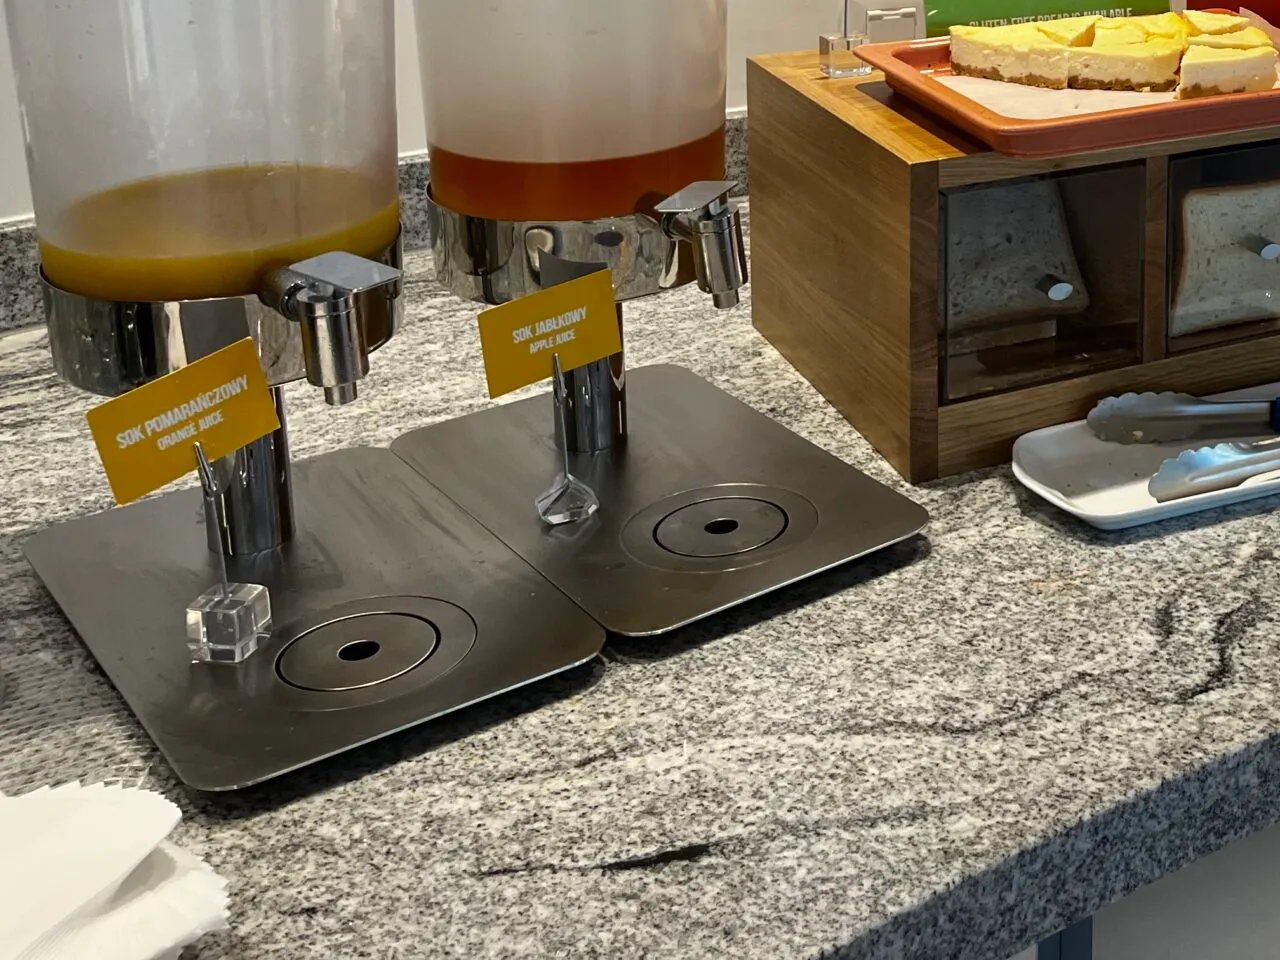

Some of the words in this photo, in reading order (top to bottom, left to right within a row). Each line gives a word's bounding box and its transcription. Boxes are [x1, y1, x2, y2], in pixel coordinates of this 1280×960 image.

[512, 326, 533, 344] SOK
[534, 306, 587, 337] JABŁKOWY
[529, 339, 554, 354] APPLE
[555, 328, 576, 346] JUICE
[116, 424, 145, 449] SOK
[144, 374, 249, 437] POMARAŃCZOWY
[156, 421, 198, 451] ORANGE
[198, 410, 225, 432] JUICE
